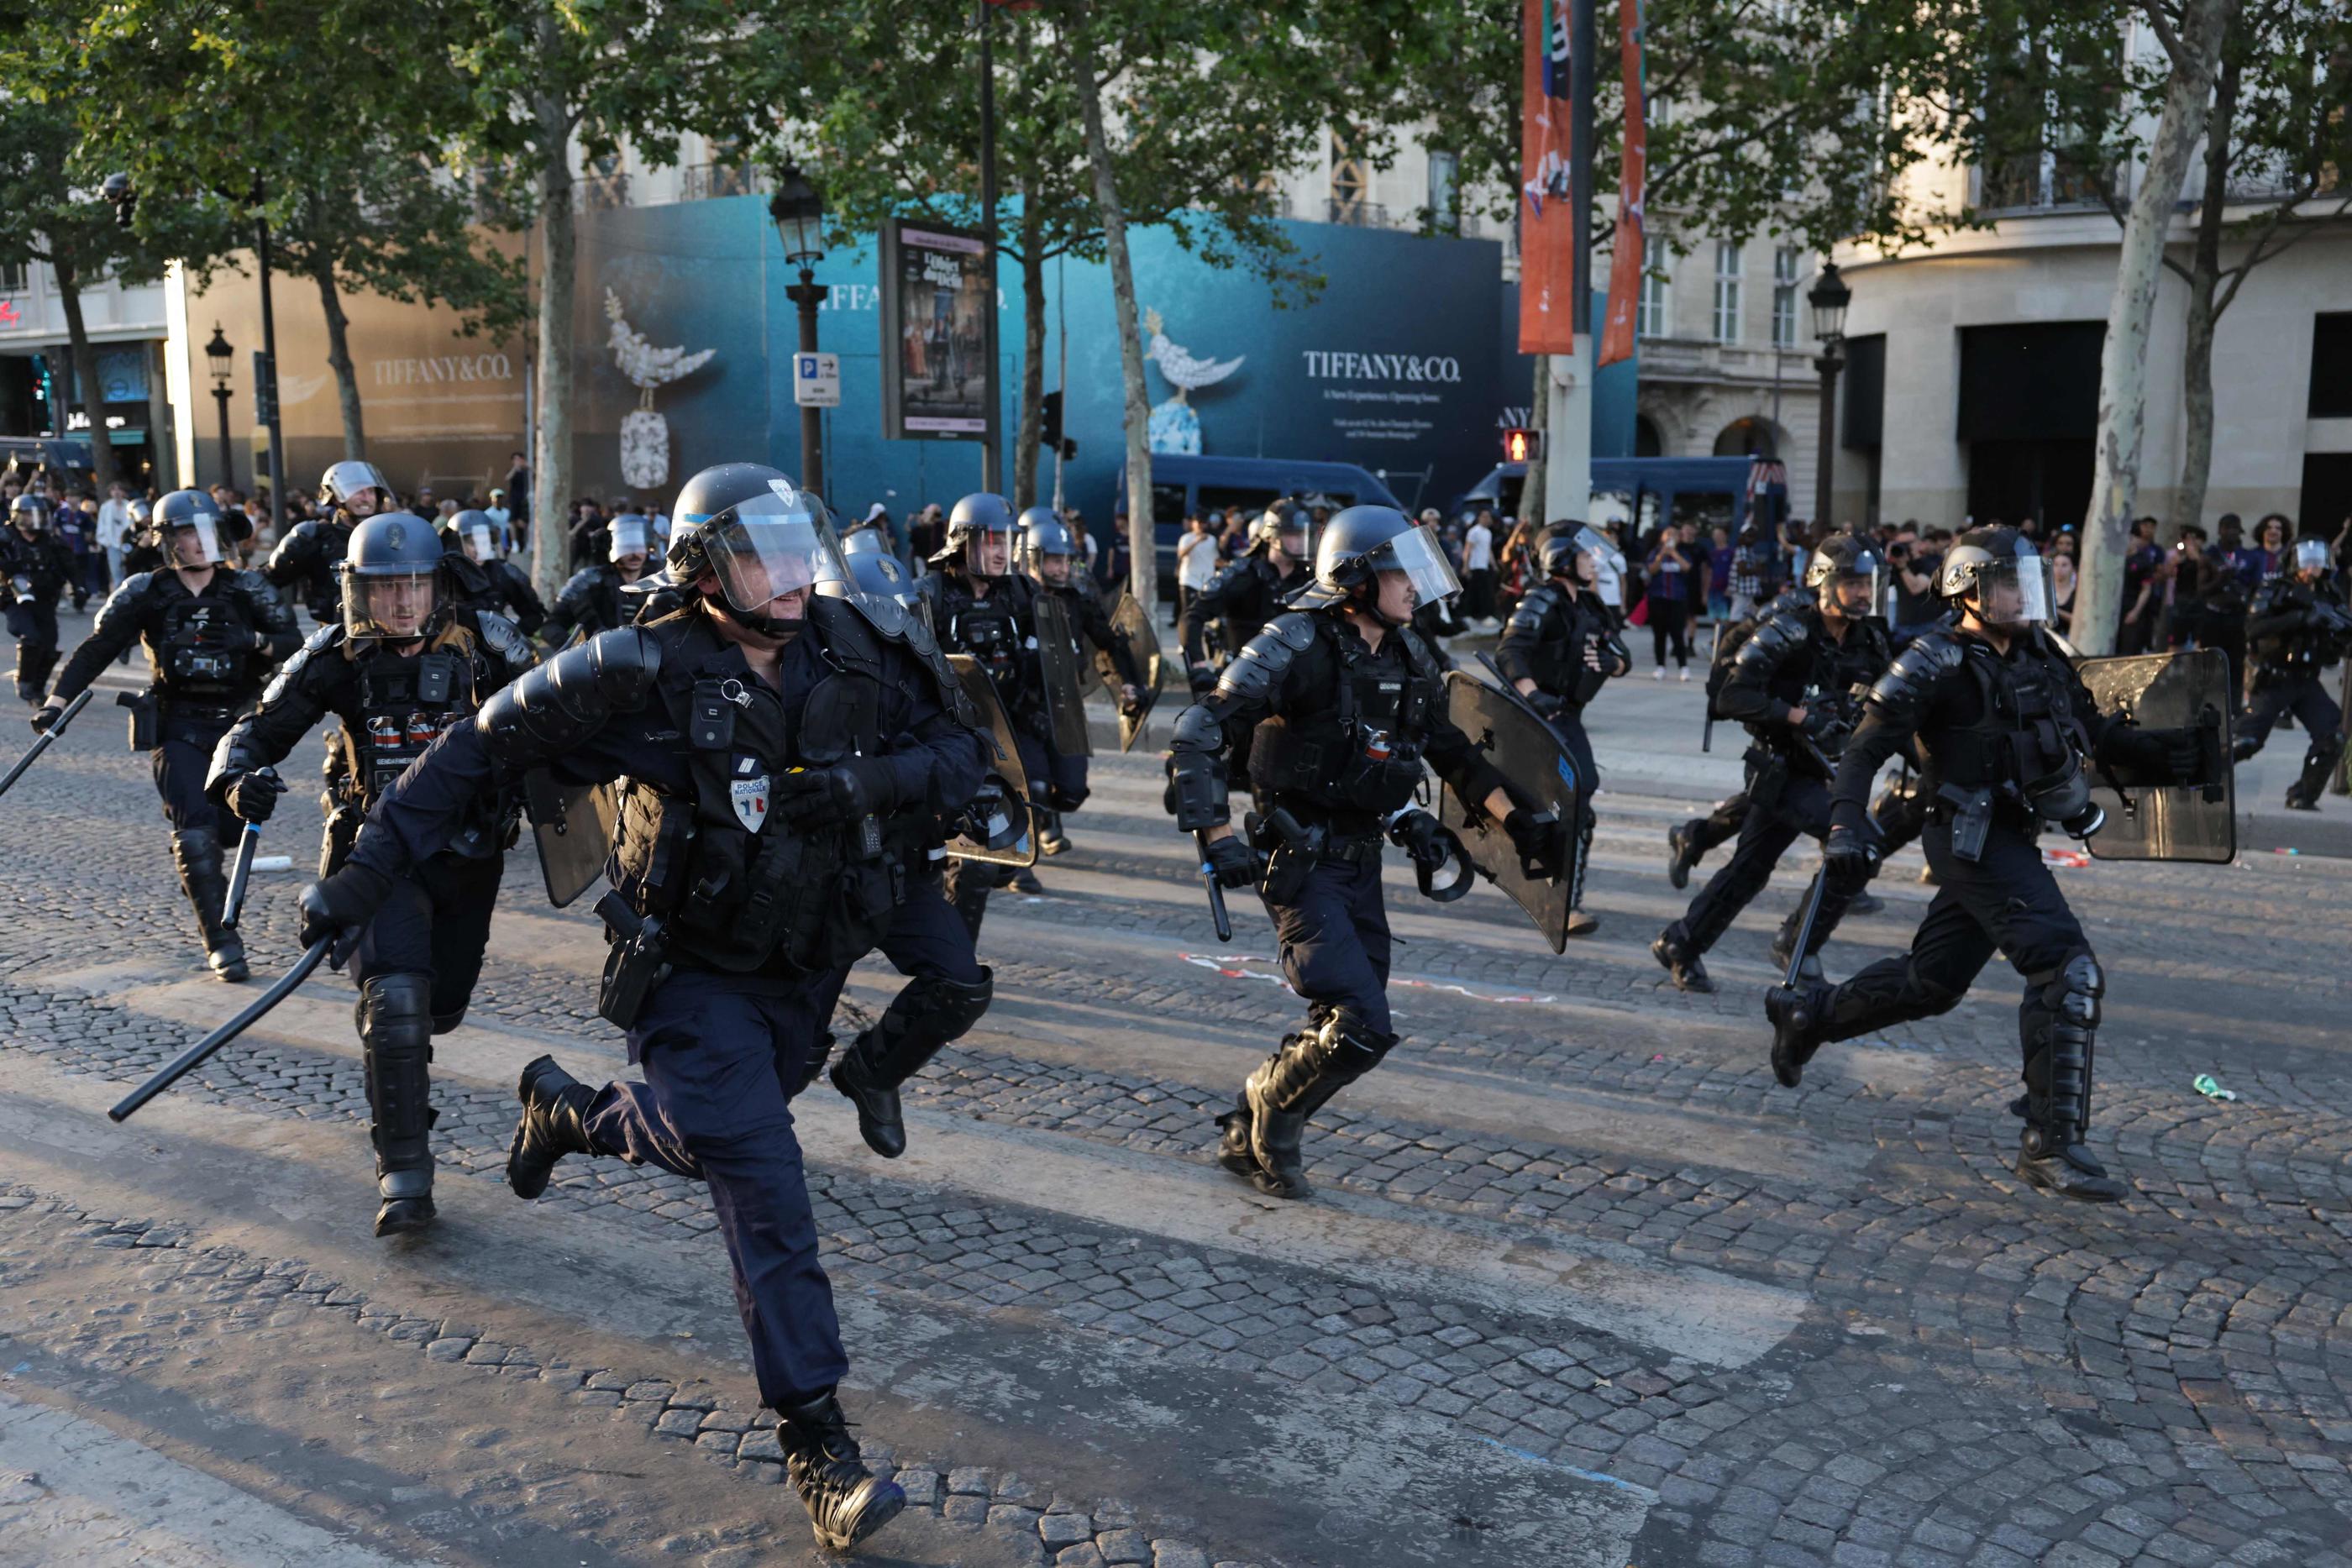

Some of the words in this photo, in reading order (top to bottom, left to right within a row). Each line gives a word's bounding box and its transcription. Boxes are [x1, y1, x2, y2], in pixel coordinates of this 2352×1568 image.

[804, 360, 814, 376] P
[734, 784, 767, 795] NATIONALE
[737, 780, 764, 789] POLICE
